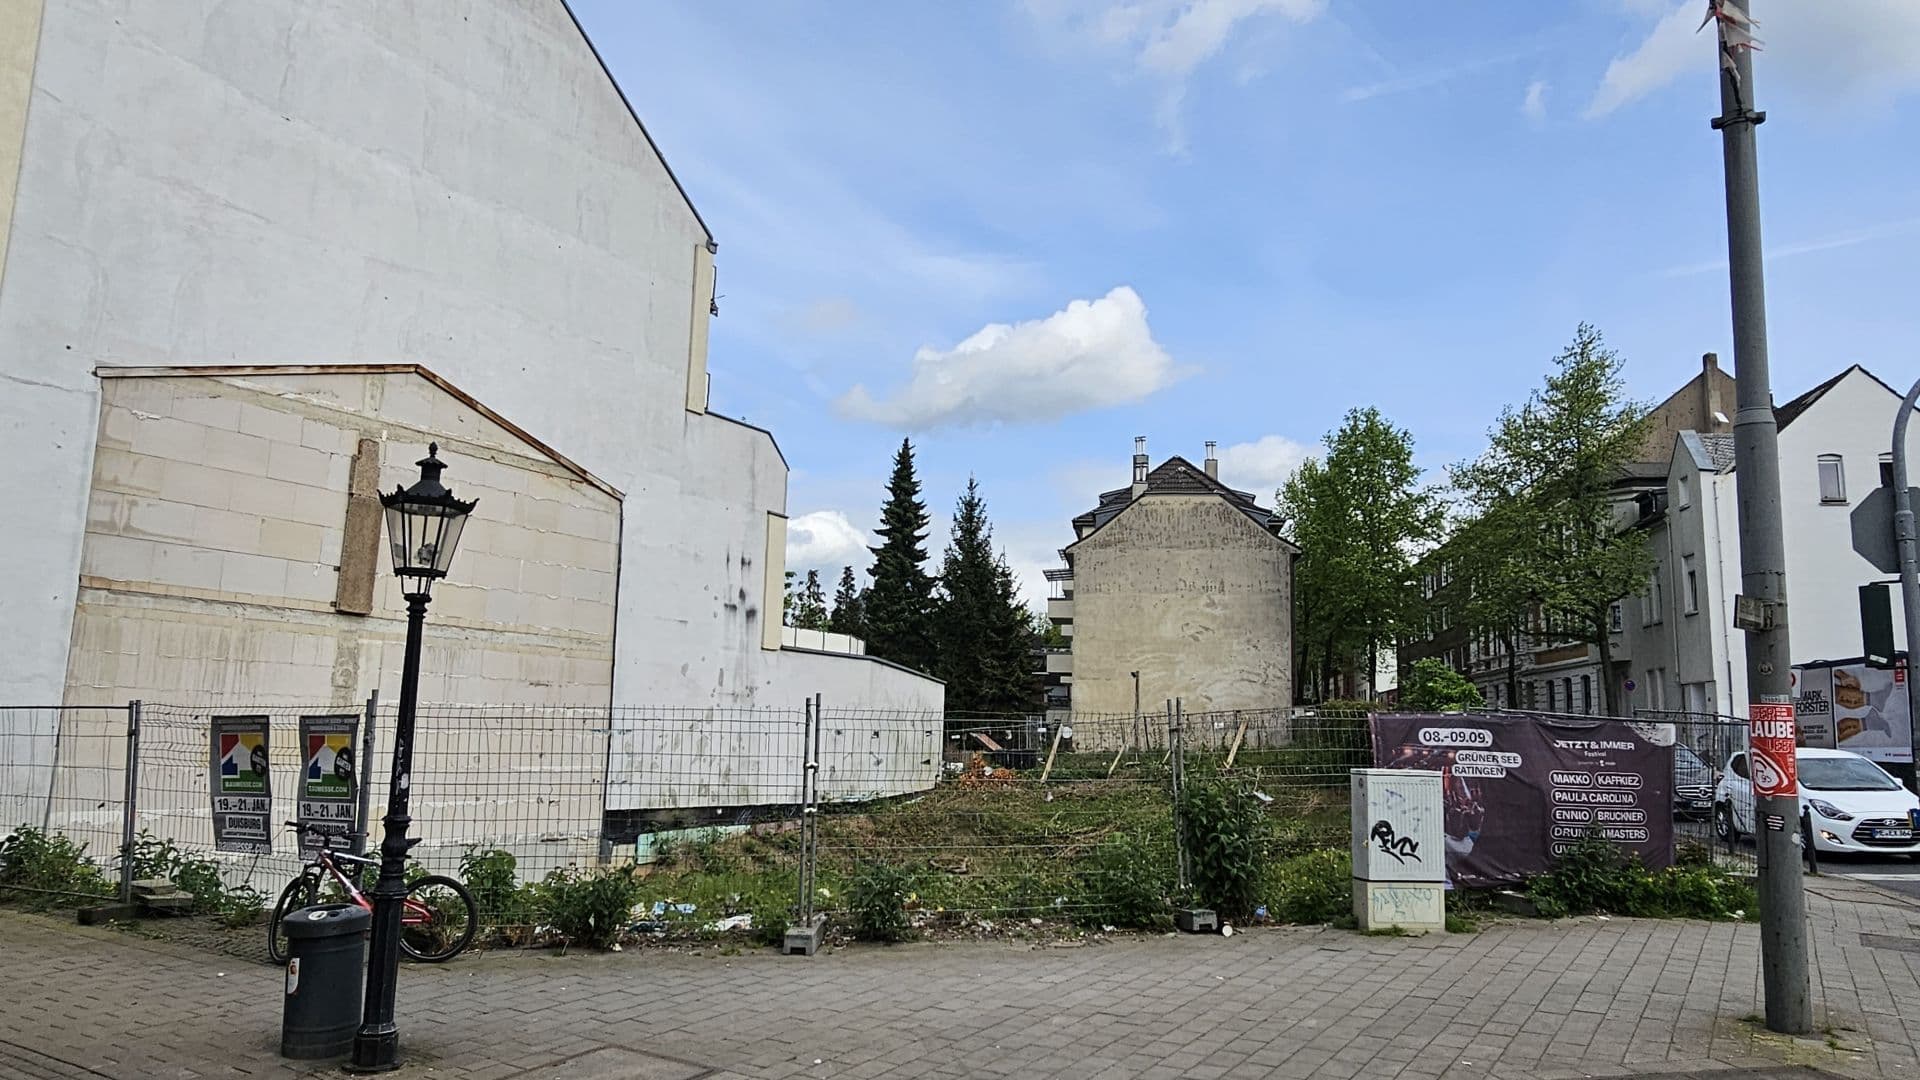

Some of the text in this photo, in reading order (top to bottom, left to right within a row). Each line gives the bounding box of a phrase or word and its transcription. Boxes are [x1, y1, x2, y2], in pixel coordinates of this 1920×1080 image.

[1423, 730, 1490, 744] 08.-09.09.
[1553, 740, 1590, 749] JETZT
[1600, 741, 1635, 750] IMMER
[1457, 752, 1520, 764] GRÜNER SEE
[1454, 766, 1504, 775] RATINGEN
[1553, 774, 1640, 785] MAKKO KAFFKIEZ
[1555, 791, 1634, 803] PAULA CAROLINA
[1556, 810, 1644, 821] ENNIO BRUCKNER
[1554, 828, 1646, 839] DRUNKN MASTERS
